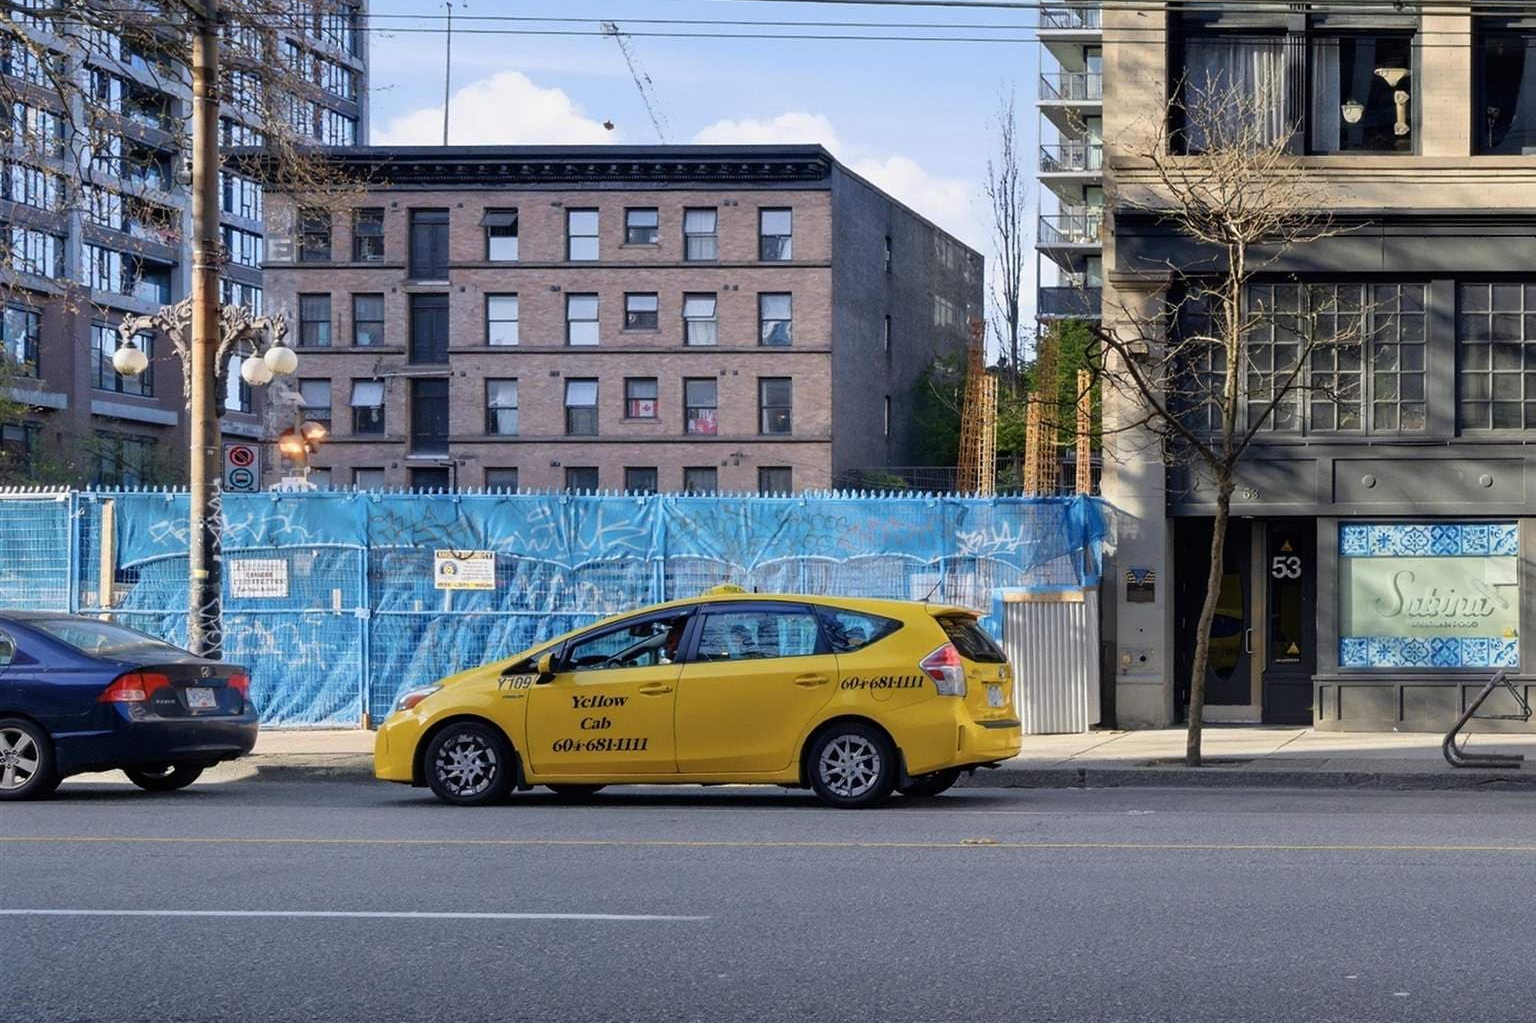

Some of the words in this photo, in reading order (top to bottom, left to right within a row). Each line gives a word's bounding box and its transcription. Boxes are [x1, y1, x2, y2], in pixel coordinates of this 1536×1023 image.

[1272, 556, 1302, 579] 53
[1376, 570, 1494, 618] Sabina
[571, 695, 629, 709] Yellow
[580, 717, 612, 730] Cab
